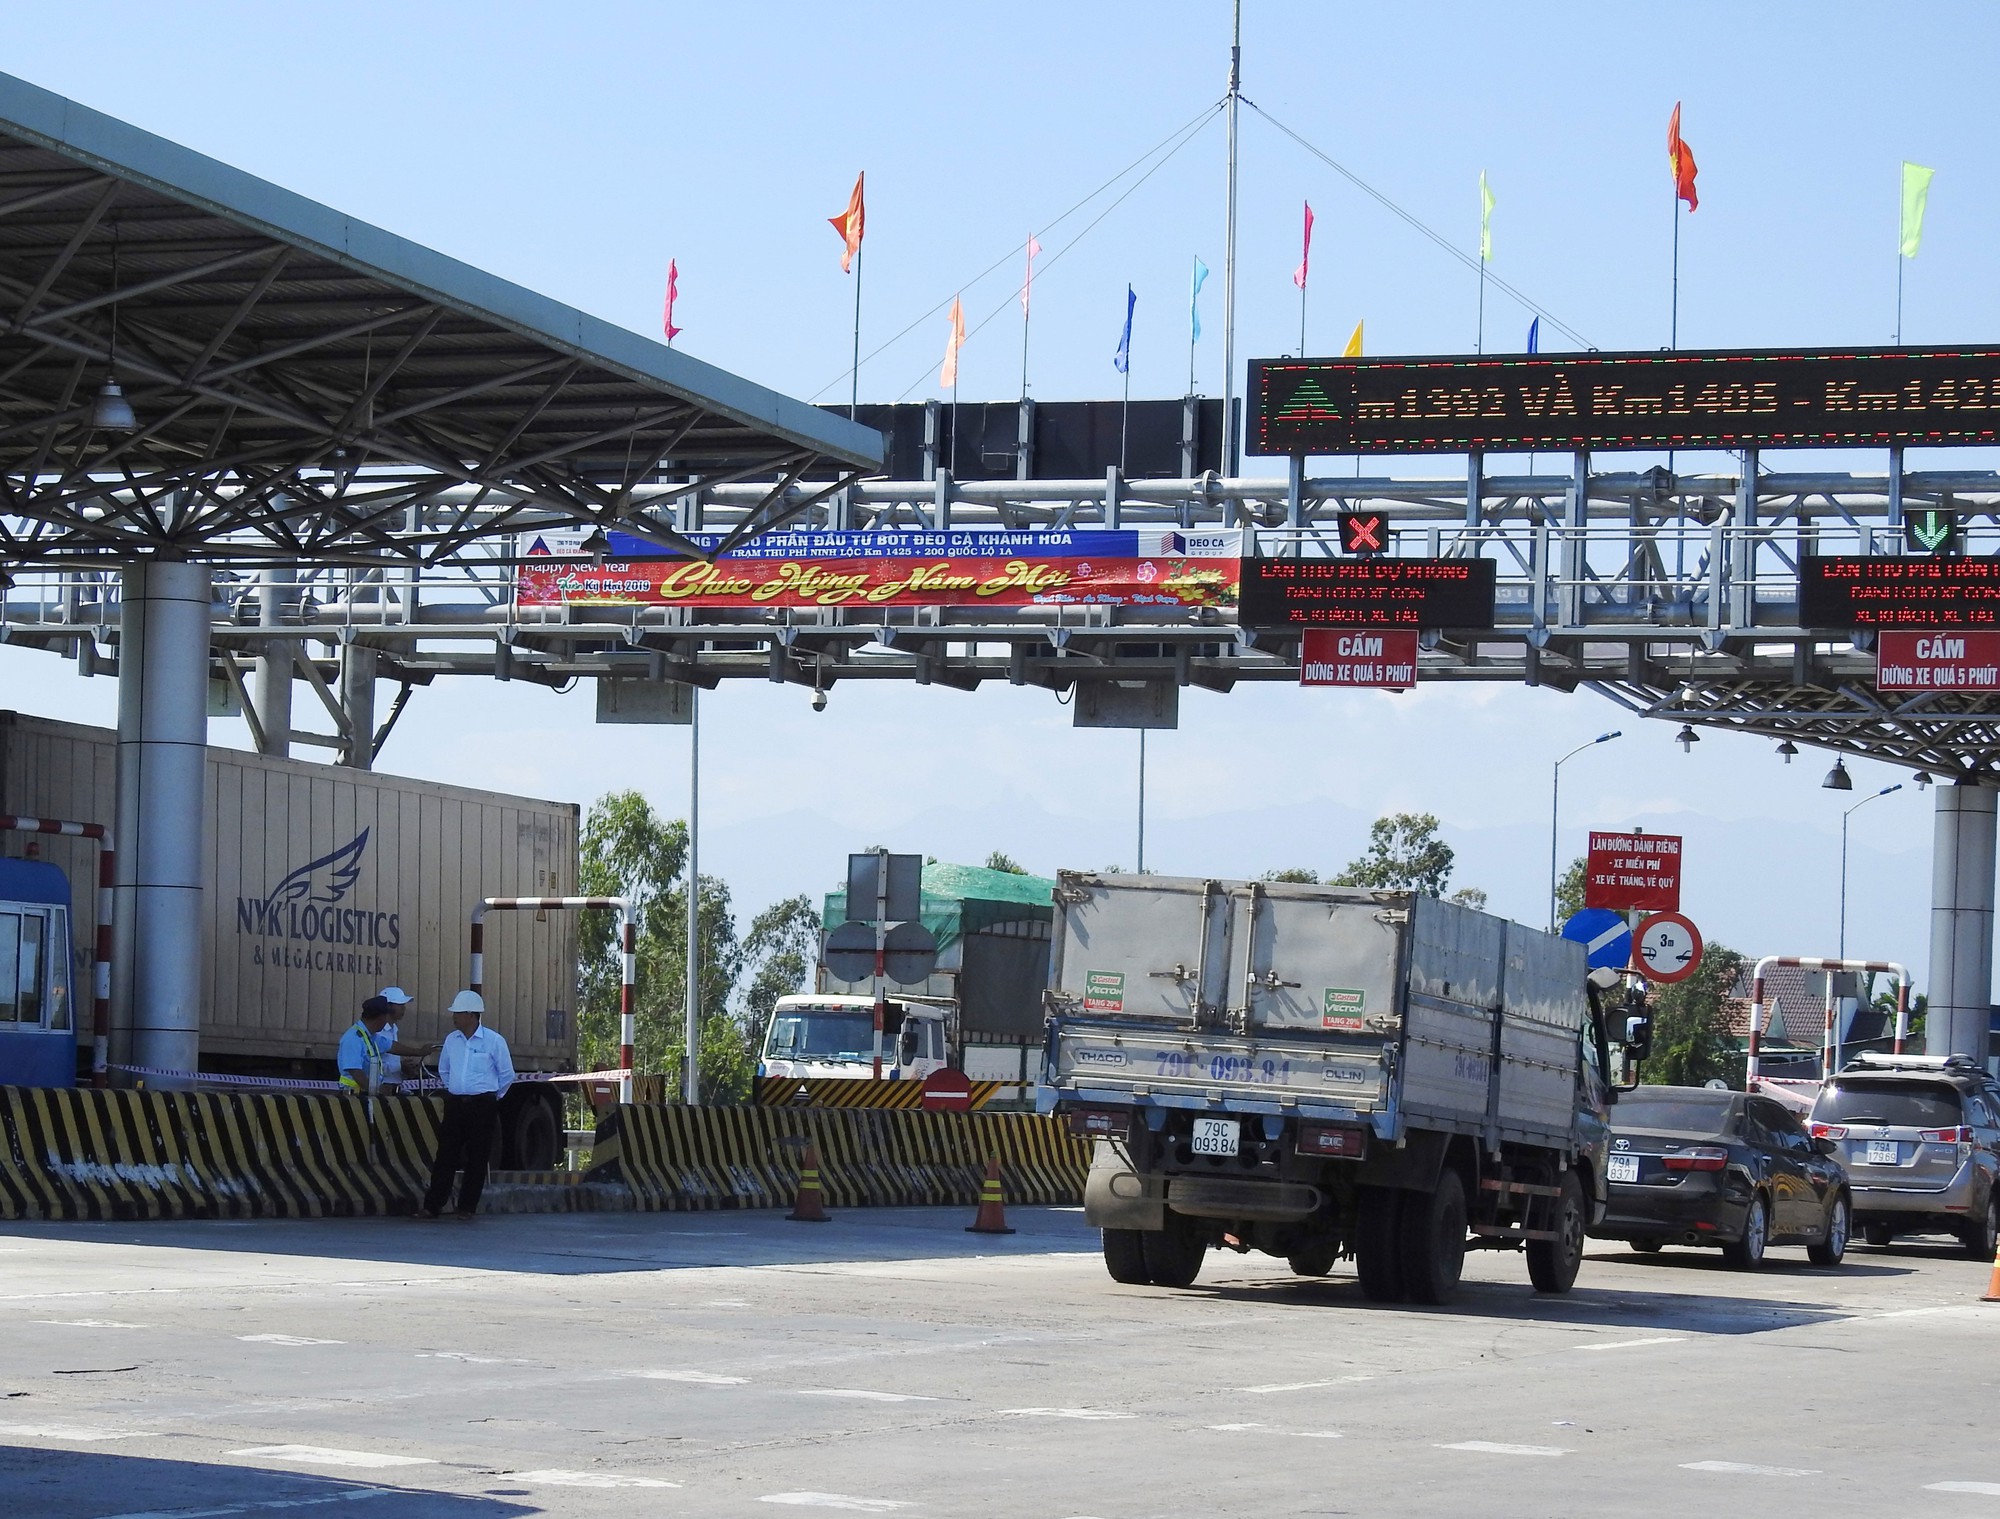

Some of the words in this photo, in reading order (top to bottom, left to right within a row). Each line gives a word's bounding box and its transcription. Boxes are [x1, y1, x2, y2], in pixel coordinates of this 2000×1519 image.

[1593, 384, 1777, 415] Km1405
[852, 535, 872, 546] TƯ
[877, 535, 908, 545] BOT
[913, 533, 945, 546] ĐÈO
[951, 531, 973, 546] CẢ
[979, 532, 1033, 545] KHÁNH
[1039, 532, 1072, 545] HÒA
[1190, 539, 1209, 548] DEO
[1212, 539, 1225, 548] CA
[732, 549, 761, 558] TRẠM
[764, 549, 786, 557] THU
[789, 547, 807, 557] PHÍ
[811, 549, 837, 557] NINH
[840, 546, 862, 558] LỘC
[886, 548, 912, 556] 1425
[925, 548, 943, 556] 200
[947, 545, 978, 557] QUỐC
[981, 546, 995, 557] LỘ
[999, 548, 1013, 556] 1A
[525, 564, 564, 573] Happy
[570, 564, 598, 573] New
[605, 563, 630, 573] Year
[624, 580, 650, 591] 2019
[661, 560, 752, 598] Chúc
[867, 563, 977, 602] Năm
[976, 561, 1071, 596] Mới
[1338, 632, 1382, 656] CẤM
[1916, 633, 1964, 659] CẤM
[1305, 660, 1333, 680] DỪNG
[1337, 665, 1350, 681] XE
[1353, 661, 1374, 682] QUÁ
[1376, 665, 1382, 682] 5
[1386, 662, 1412, 682] PHÚT
[1881, 664, 1913, 684] DỪNG
[1916, 668, 1930, 684] XE
[1934, 664, 1955, 686] QUÁ
[1958, 669, 1965, 684] 5
[1969, 664, 1998, 684] PHÚT
[1592, 835, 1606, 851] LÀN
[1607, 836, 1632, 852] ĐƯỜNG
[1633, 837, 1654, 853] DÀNH
[1656, 839, 1678, 854] RIÊNG
[1614, 858, 1623, 868] XE
[1625, 856, 1644, 869] MIỄN
[1647, 858, 1661, 870] PHÍ
[1596, 875, 1605, 885] XE
[1619, 874, 1646, 888] THÁNG,
[1659, 876, 1674, 888] QUÝ
[237, 896, 283, 937] NYK
[290, 902, 400, 949] LOGISTICS
[254, 944, 263, 965] &
[1080, 1051, 1123, 1064] THACO
[1325, 1069, 1361, 1081] OLLIN
[1204, 1122, 1228, 1137] 79C
[1194, 1137, 1236, 1153] 093.84
[1875, 1142, 1890, 1152] 79A
[1612, 1157, 1630, 1168] 79A
[1868, 1152, 1896, 1162] 179.69
[1610, 1169, 1635, 1180] 83.71
